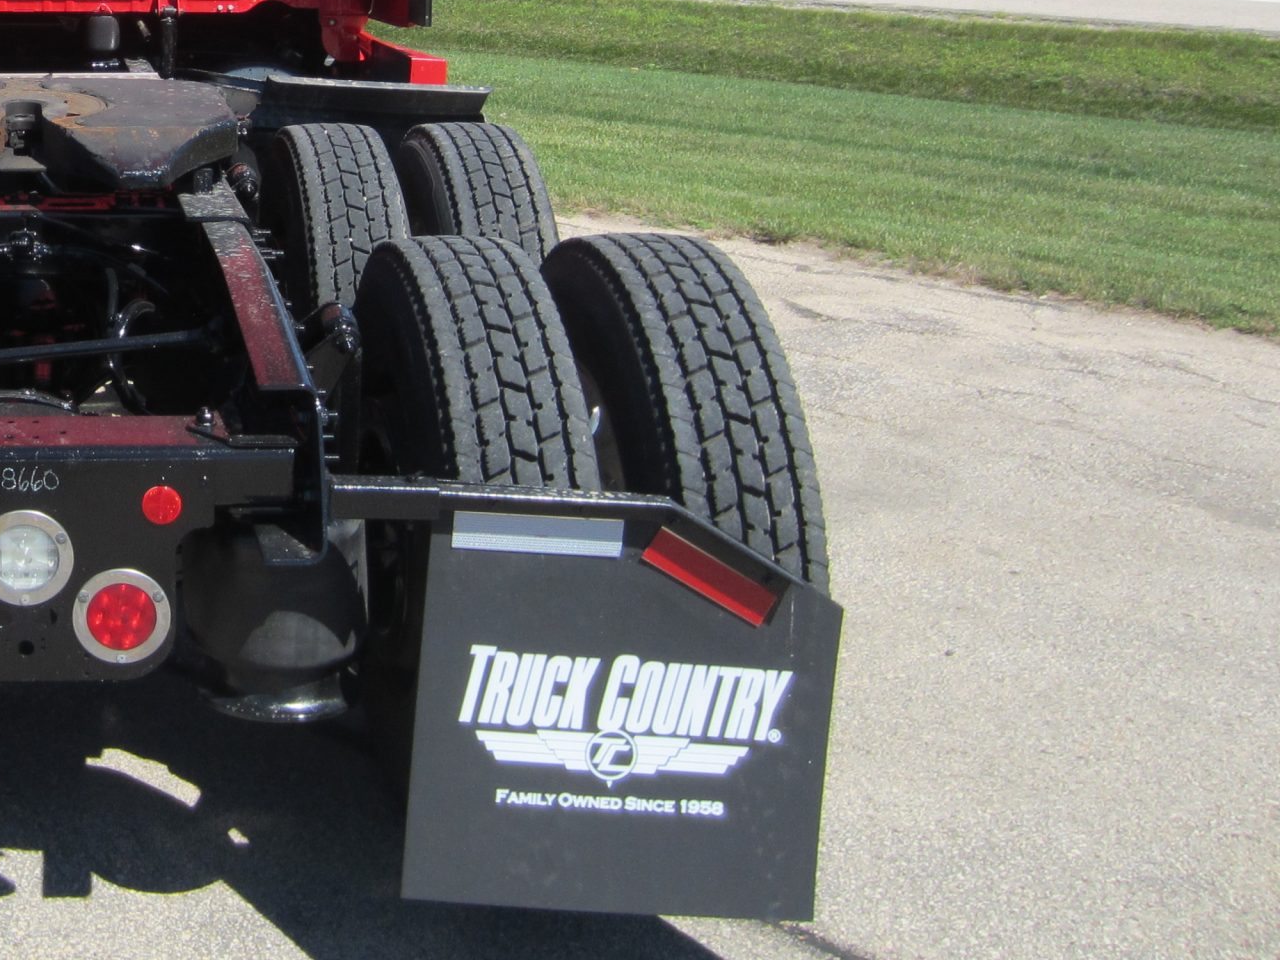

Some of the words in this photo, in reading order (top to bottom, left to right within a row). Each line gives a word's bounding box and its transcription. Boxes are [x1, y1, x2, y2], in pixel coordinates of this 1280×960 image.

[458, 644, 601, 730] TRUCK
[495, 788, 556, 806] FAMILY
[557, 792, 622, 810] OWNED
[624, 795, 676, 813] SINCE
[680, 798, 724, 816] 1958
